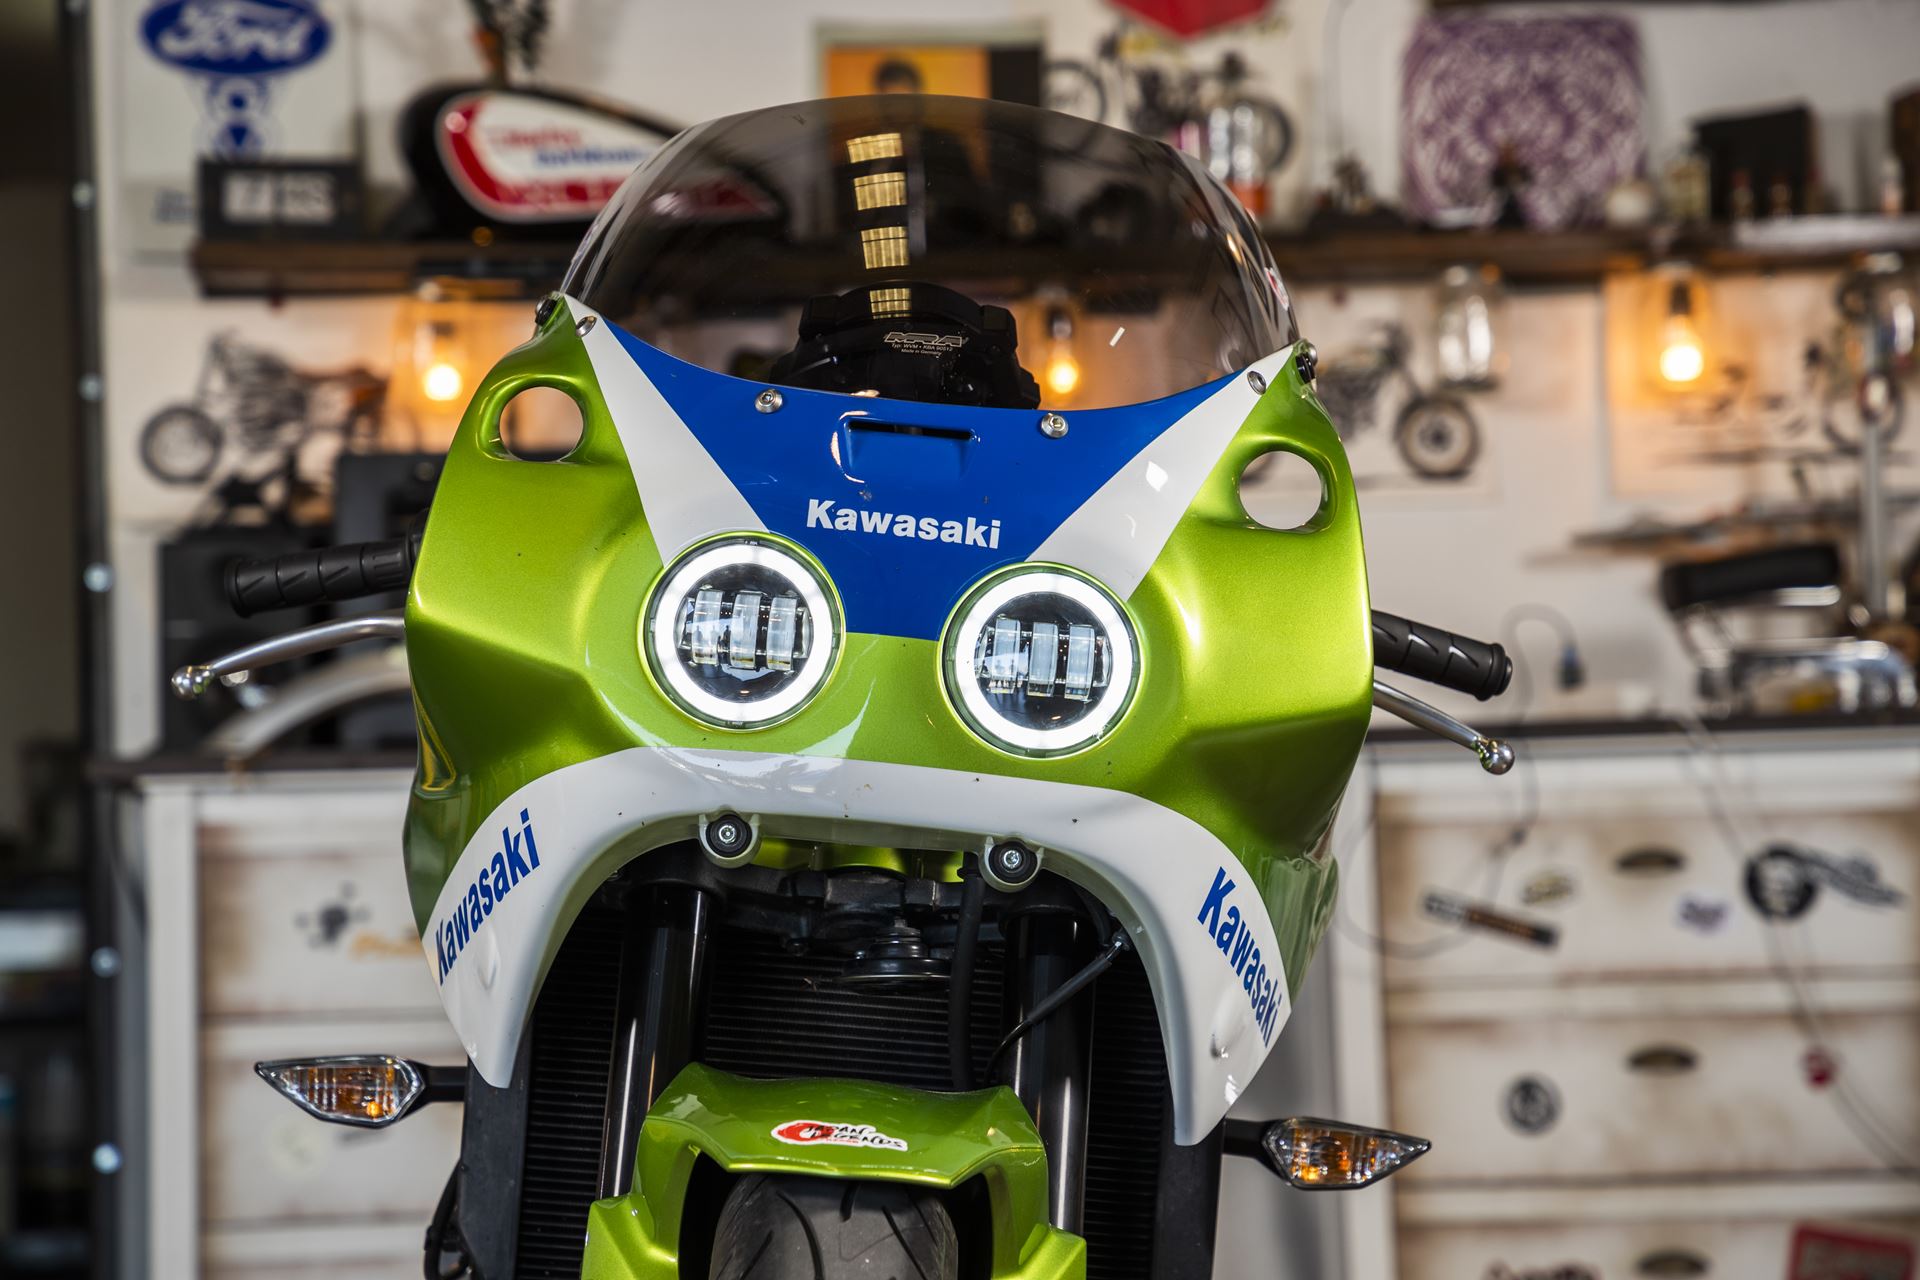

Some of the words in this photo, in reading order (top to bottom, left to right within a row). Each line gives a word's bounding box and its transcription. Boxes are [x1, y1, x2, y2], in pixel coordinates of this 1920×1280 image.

[157, 2, 310, 61] Ford
[806, 498, 1001, 550] Kawasaki
[435, 807, 540, 986] Kawasaki
[1197, 866, 1283, 1048] Kawasaki
